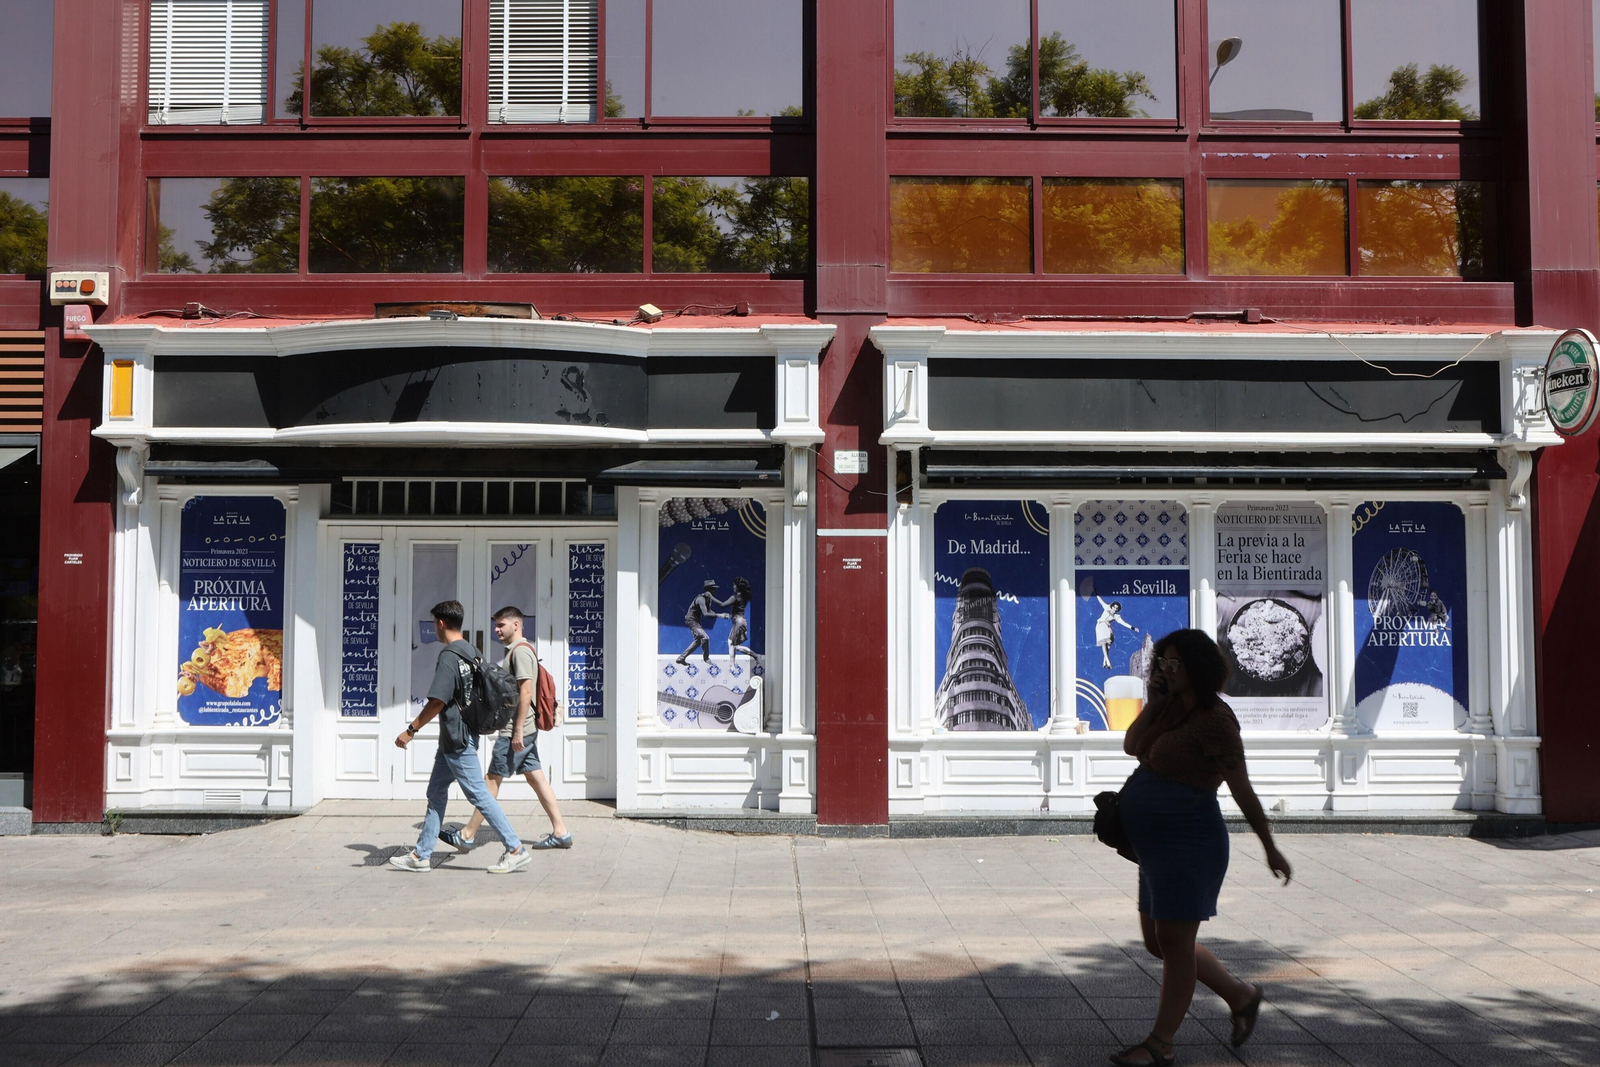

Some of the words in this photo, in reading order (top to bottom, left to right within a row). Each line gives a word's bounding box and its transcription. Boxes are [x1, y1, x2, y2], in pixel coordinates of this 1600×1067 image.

[1565, 396, 1582, 418] QUALITY
[1217, 515, 1266, 524] NOTICIERO
[1269, 515, 1281, 524] DE
[1283, 515, 1321, 524] SEVILLA
[947, 540, 966, 554] De
[970, 540, 1030, 554] Madrid...
[1217, 533, 1234, 547] La
[1238, 533, 1278, 550] previa
[1282, 536, 1289, 547] a
[1294, 533, 1305, 547] la
[183, 559, 227, 567] NOTICIERO
[229, 559, 240, 567] DE
[242, 559, 276, 567] SEVILLA
[1218, 549, 1251, 563] Feria
[1255, 553, 1268, 563] se
[1272, 549, 1301, 563] hace
[1217, 569, 1232, 580] en
[1237, 566, 1248, 580] la
[1253, 566, 1322, 580] Bientirada
[194, 576, 267, 595] PRÓXIMA
[1133, 580, 1177, 594] Sevilla
[187, 596, 272, 611] APERTURA
[1367, 632, 1451, 646] APERTURA
